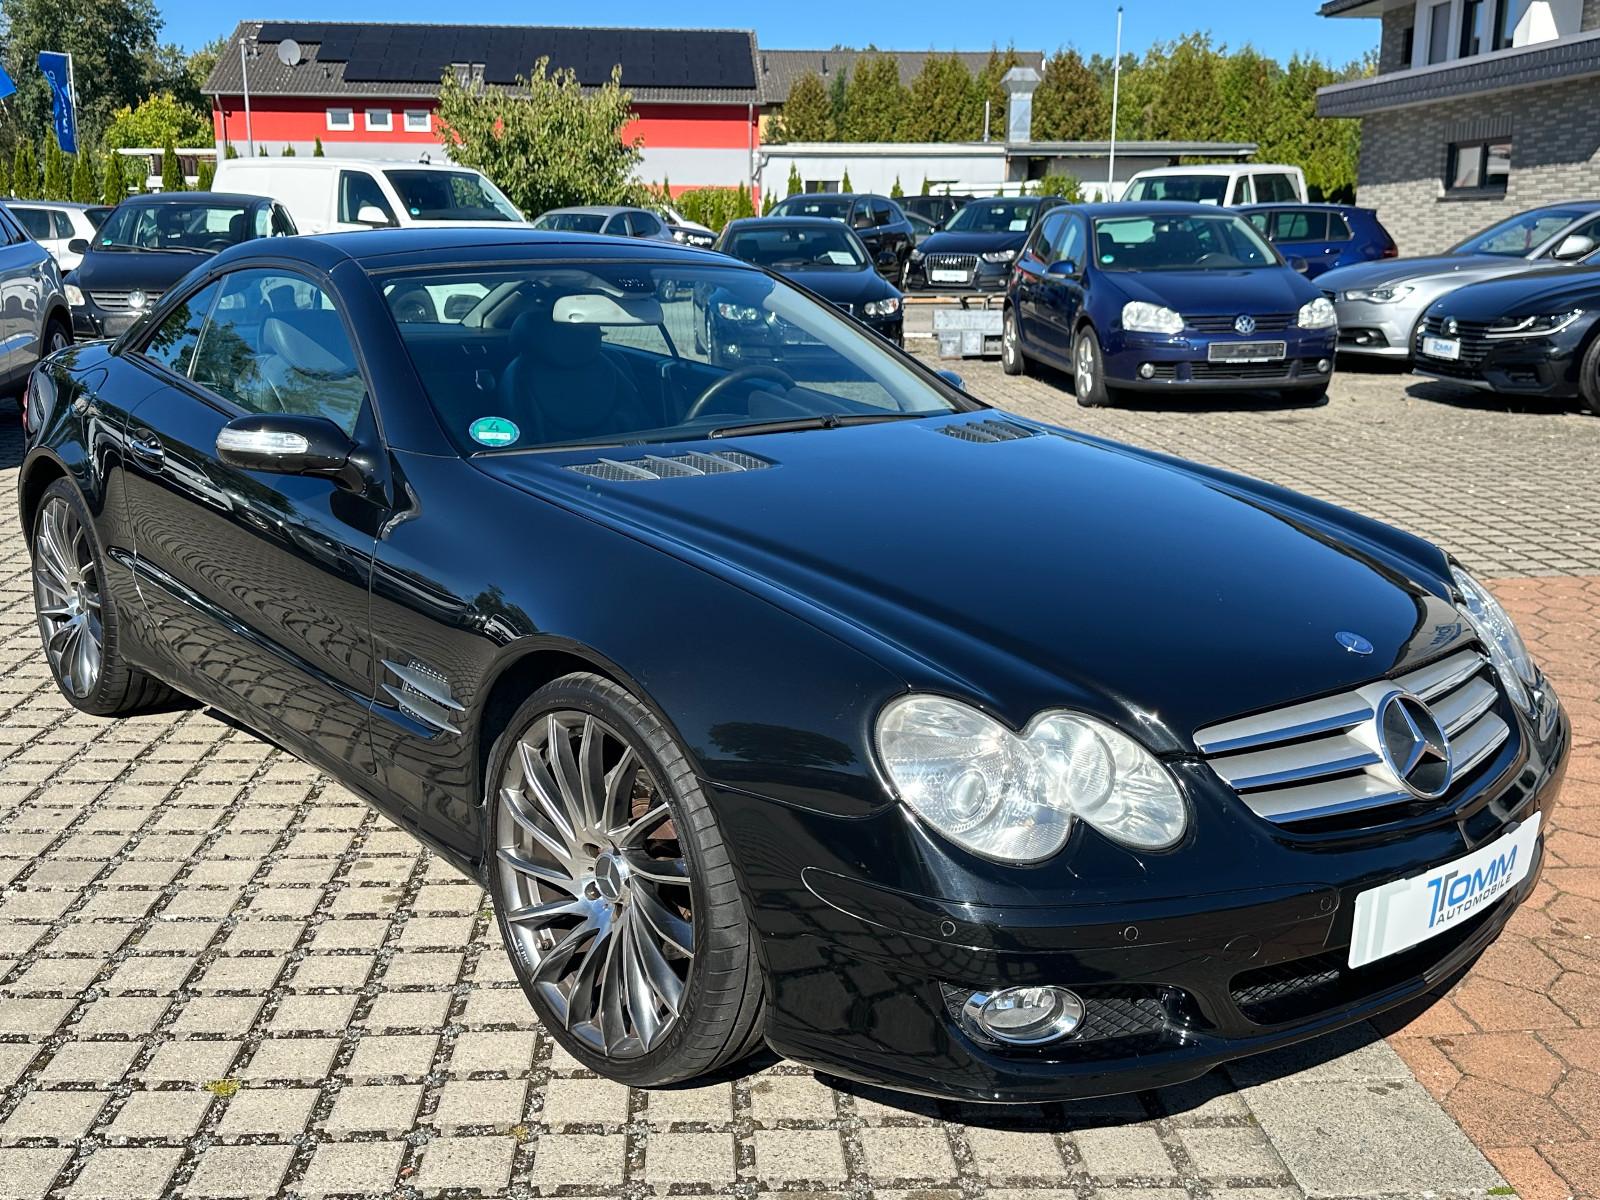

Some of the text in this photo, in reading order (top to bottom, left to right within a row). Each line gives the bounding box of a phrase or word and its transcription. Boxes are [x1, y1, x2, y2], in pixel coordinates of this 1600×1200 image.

[488, 421, 499, 432] 4
[1427, 845, 1517, 928] TOMM
[1436, 873, 1512, 925] AUTOMOBILE
